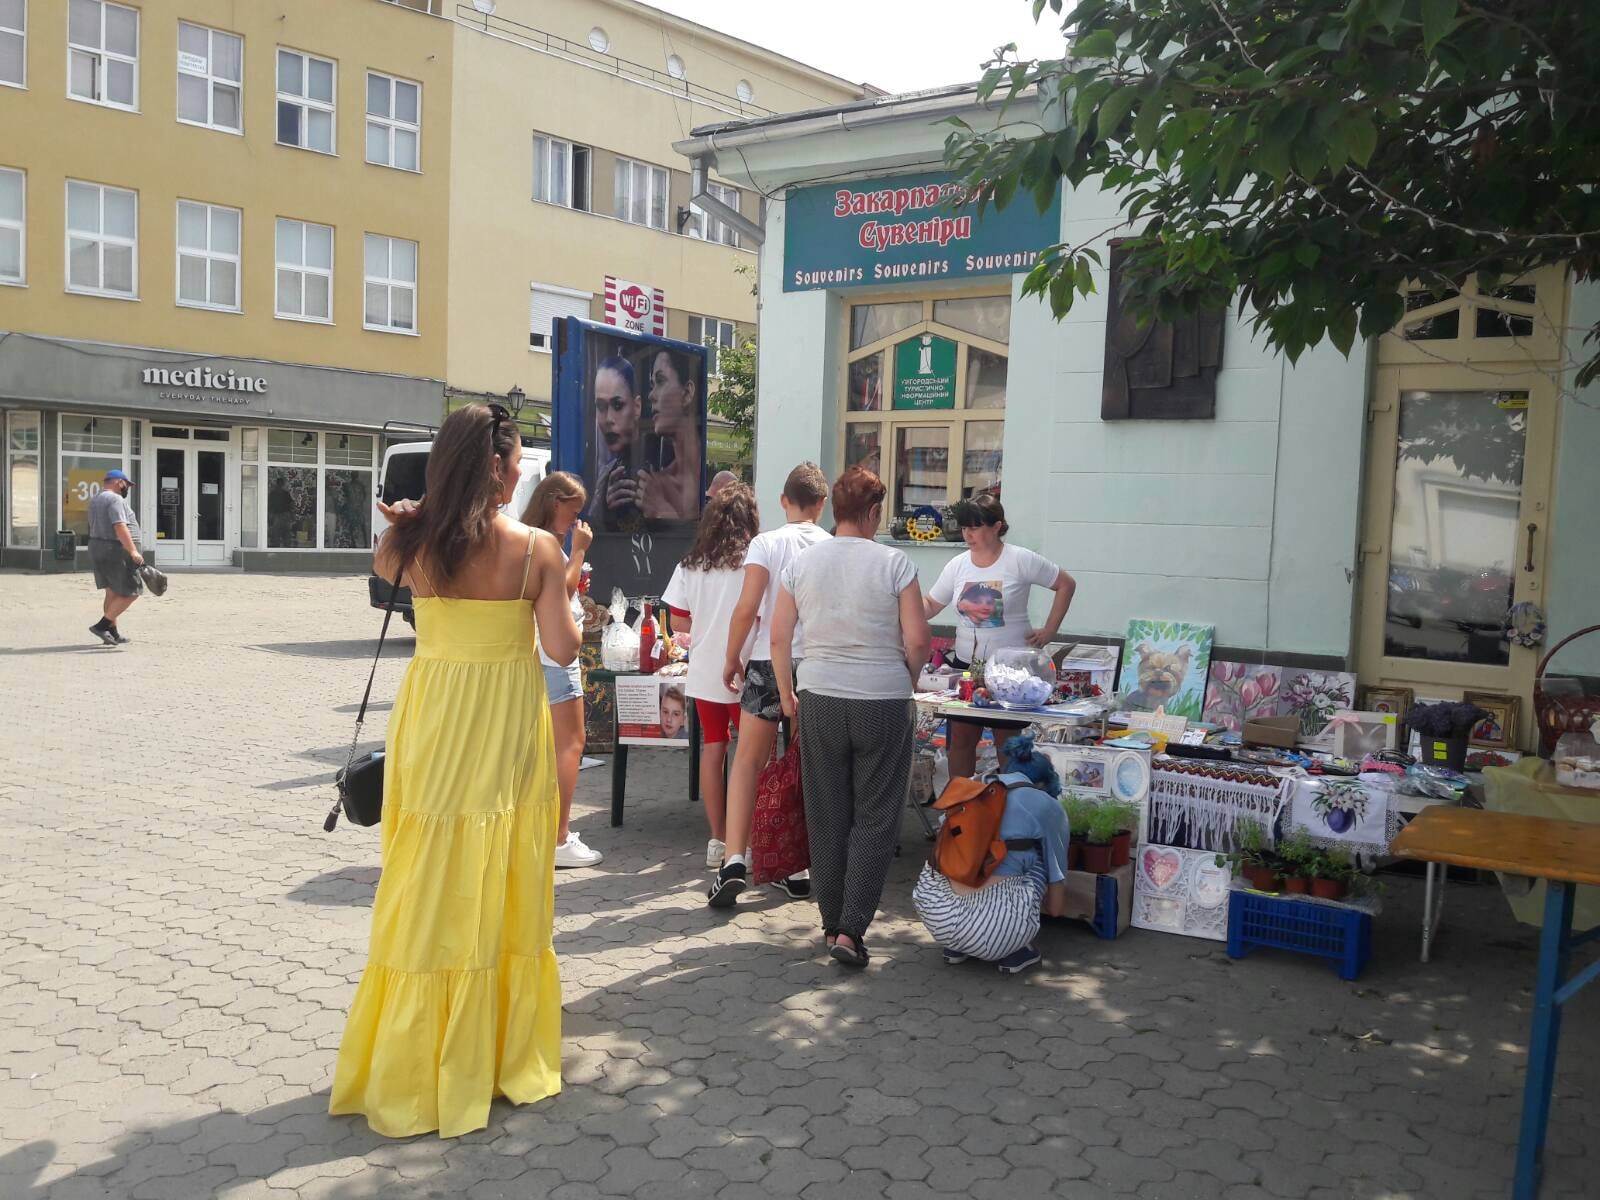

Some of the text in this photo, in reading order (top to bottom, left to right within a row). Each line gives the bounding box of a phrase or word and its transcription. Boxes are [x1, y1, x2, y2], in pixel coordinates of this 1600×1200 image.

[834, 177, 999, 218] Закарпат
[859, 215, 972, 252] Сувеніри
[795, 266, 864, 286] Souvenirs
[874, 259, 949, 279] Souvenirs
[625, 319, 645, 332] ZONE
[142, 367, 268, 393] medicine
[160, 391, 250, 405] EVERYDAY THERAPY
